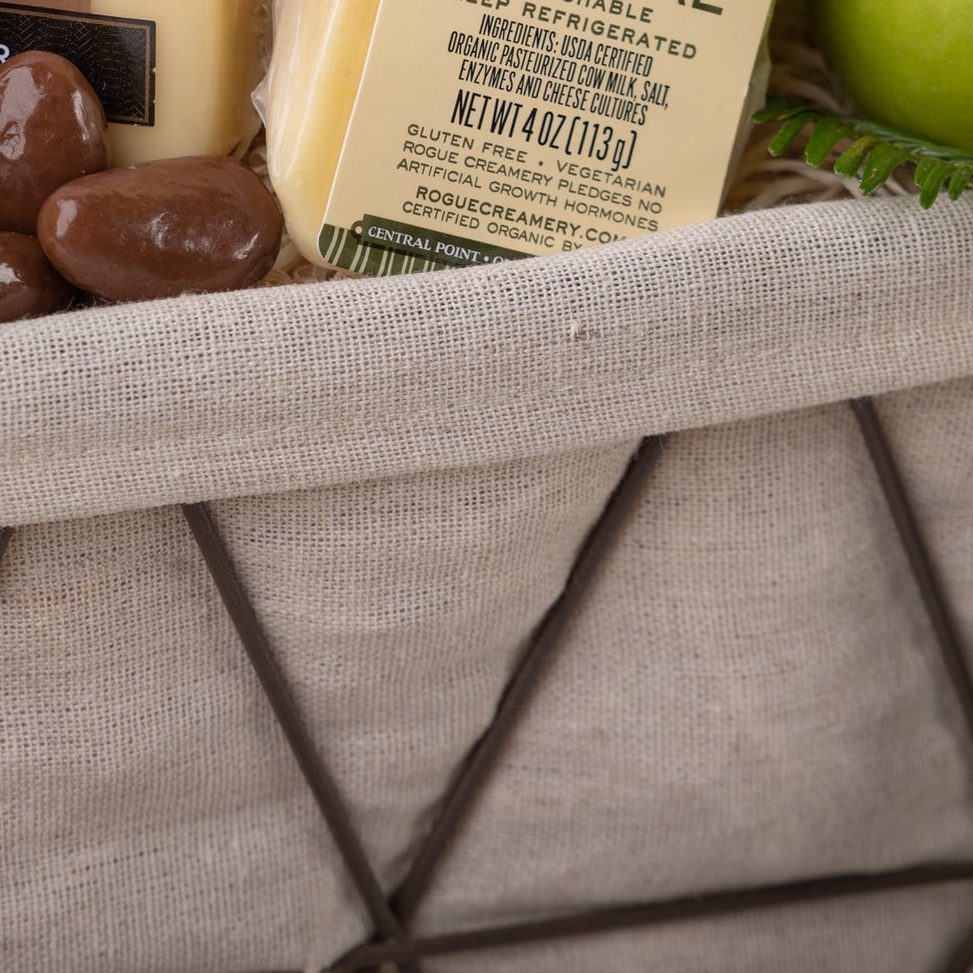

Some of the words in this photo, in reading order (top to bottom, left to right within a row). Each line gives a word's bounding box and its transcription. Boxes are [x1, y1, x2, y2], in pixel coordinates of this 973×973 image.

[479, 14, 559, 54] INGREDIENTS:
[561, 35, 591, 62] USDA
[594, 44, 653, 77] CERTIFIED
[522, 4, 697, 60] REFRIGERATED
[447, 31, 498, 62] ORGANIC
[500, 44, 577, 83] PASTEURIZED
[577, 64, 607, 90] COW
[606, 71, 638, 101] MILK,
[642, 81, 670, 110] SALT,
[458, 59, 516, 93] ENZYMES
[516, 75, 542, 99] AND
[543, 81, 590, 114] CHEESE
[590, 93, 649, 126] CULTURES
[451, 89, 492, 131] NET
[490, 99, 523, 138] WT
[521, 107, 538, 143] 4
[537, 112, 566, 150] OZ
[403, 140, 459, 165] ROGUE
[463, 156, 553, 187] CREAMERY
[558, 179, 632, 208] PLEDGES
[635, 199, 663, 215] NO
[407, 123, 475, 150] GLUTEN
[482, 142, 528, 163] FREE
[556, 160, 667, 198] VEGETARIAN
[396, 158, 482, 189] ARTIFICIAL
[489, 181, 558, 208] GROWTH
[565, 199, 659, 232] HORMONES
[402, 201, 480, 230] CERTIFIED
[486, 222, 555, 249] ORGANIC
[368, 225, 432, 251] CENTRAL
[435, 241, 481, 262] POINT
